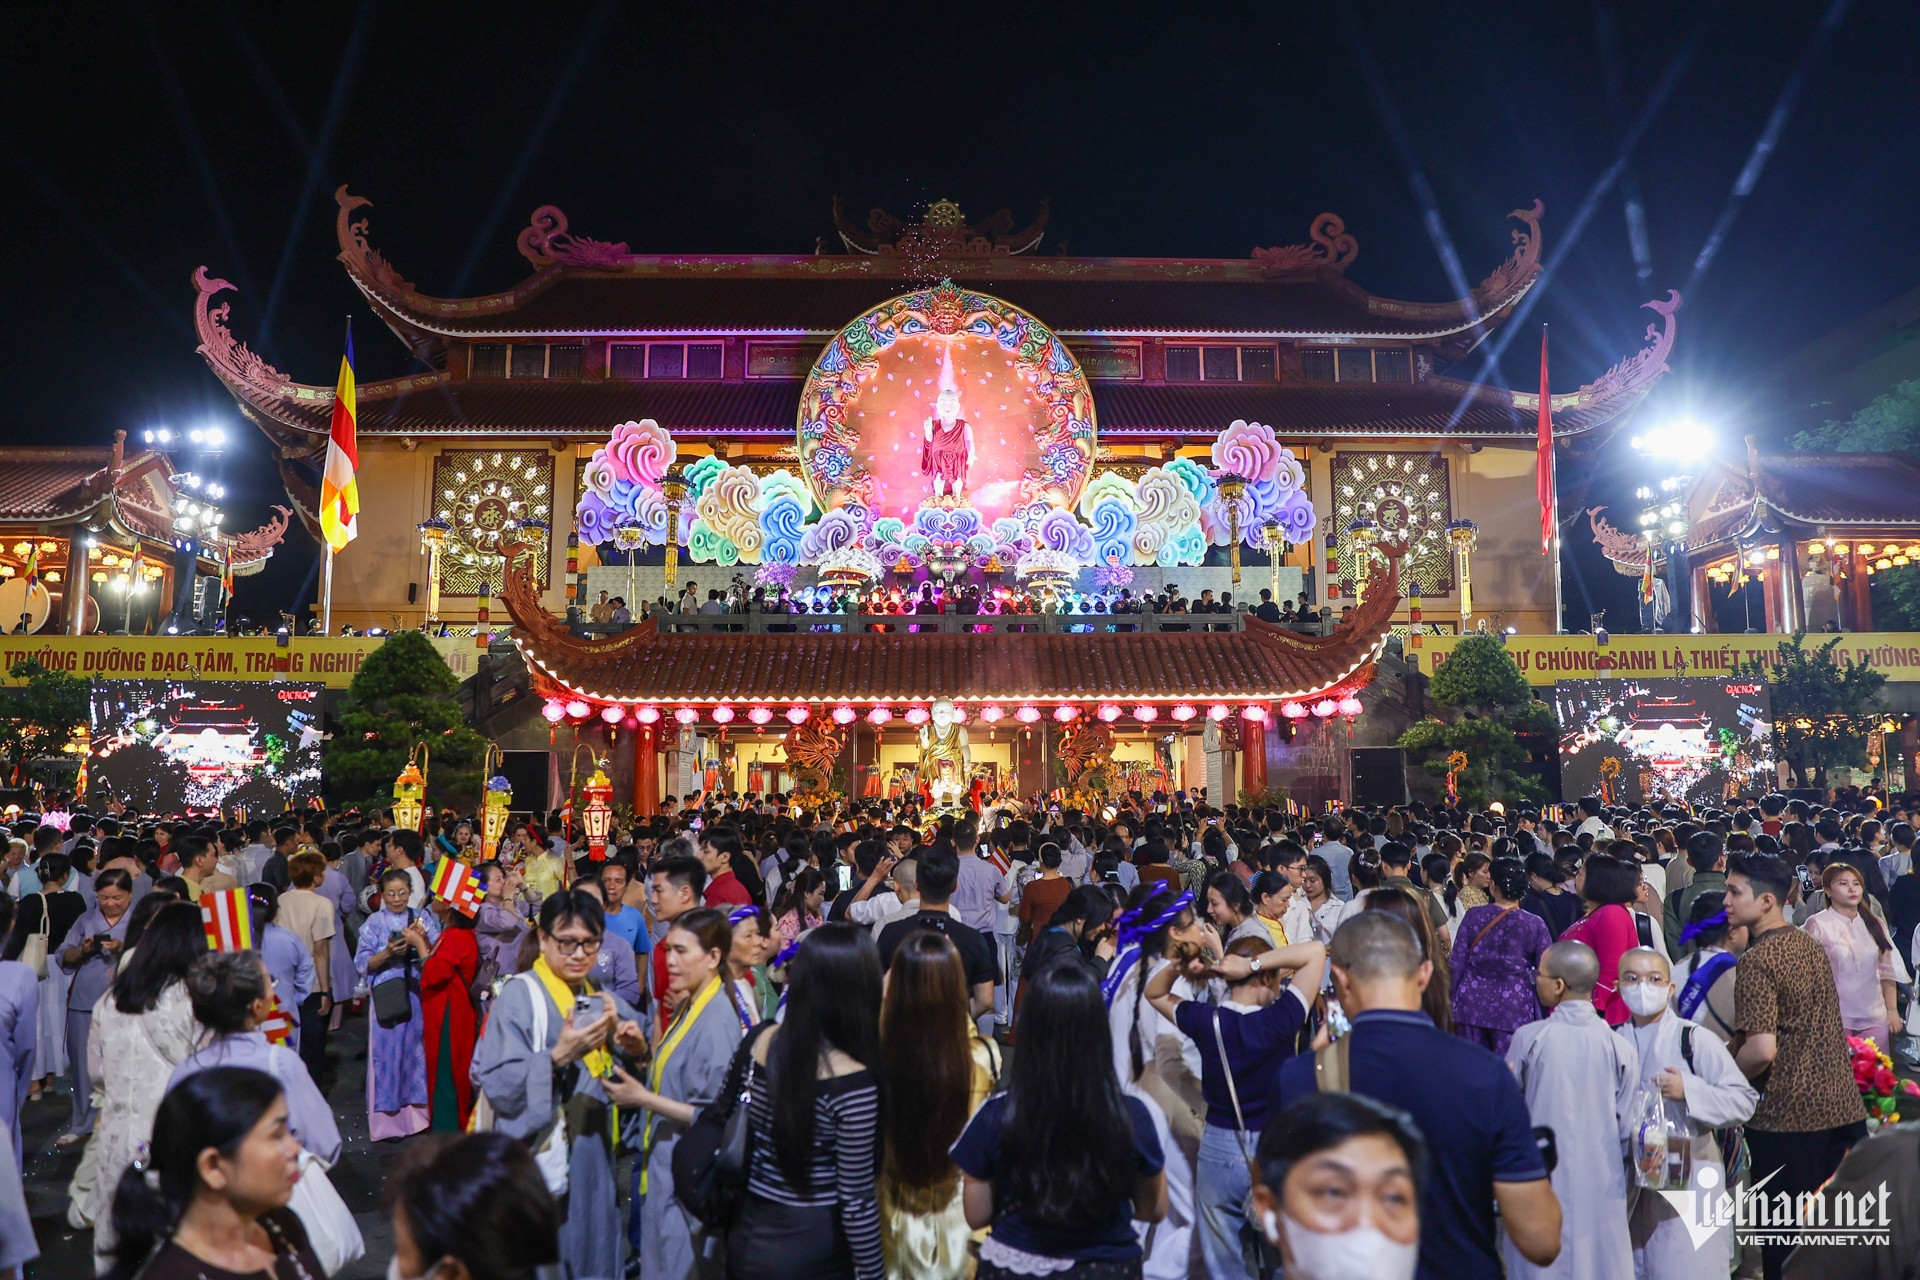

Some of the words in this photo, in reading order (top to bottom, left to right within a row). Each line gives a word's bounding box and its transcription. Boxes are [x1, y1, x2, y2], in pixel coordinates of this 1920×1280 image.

[83, 646, 146, 672] DƯỠNG
[151, 651, 188, 676] ĐẠO
[194, 647, 238, 675] TÂM,
[310, 648, 373, 673] NGHIÊ
[1535, 646, 1600, 671] CHÚNG
[1607, 650, 1657, 670] SANH
[1662, 646, 1685, 670] LÀ
[1690, 643, 1741, 670] THIẾT
